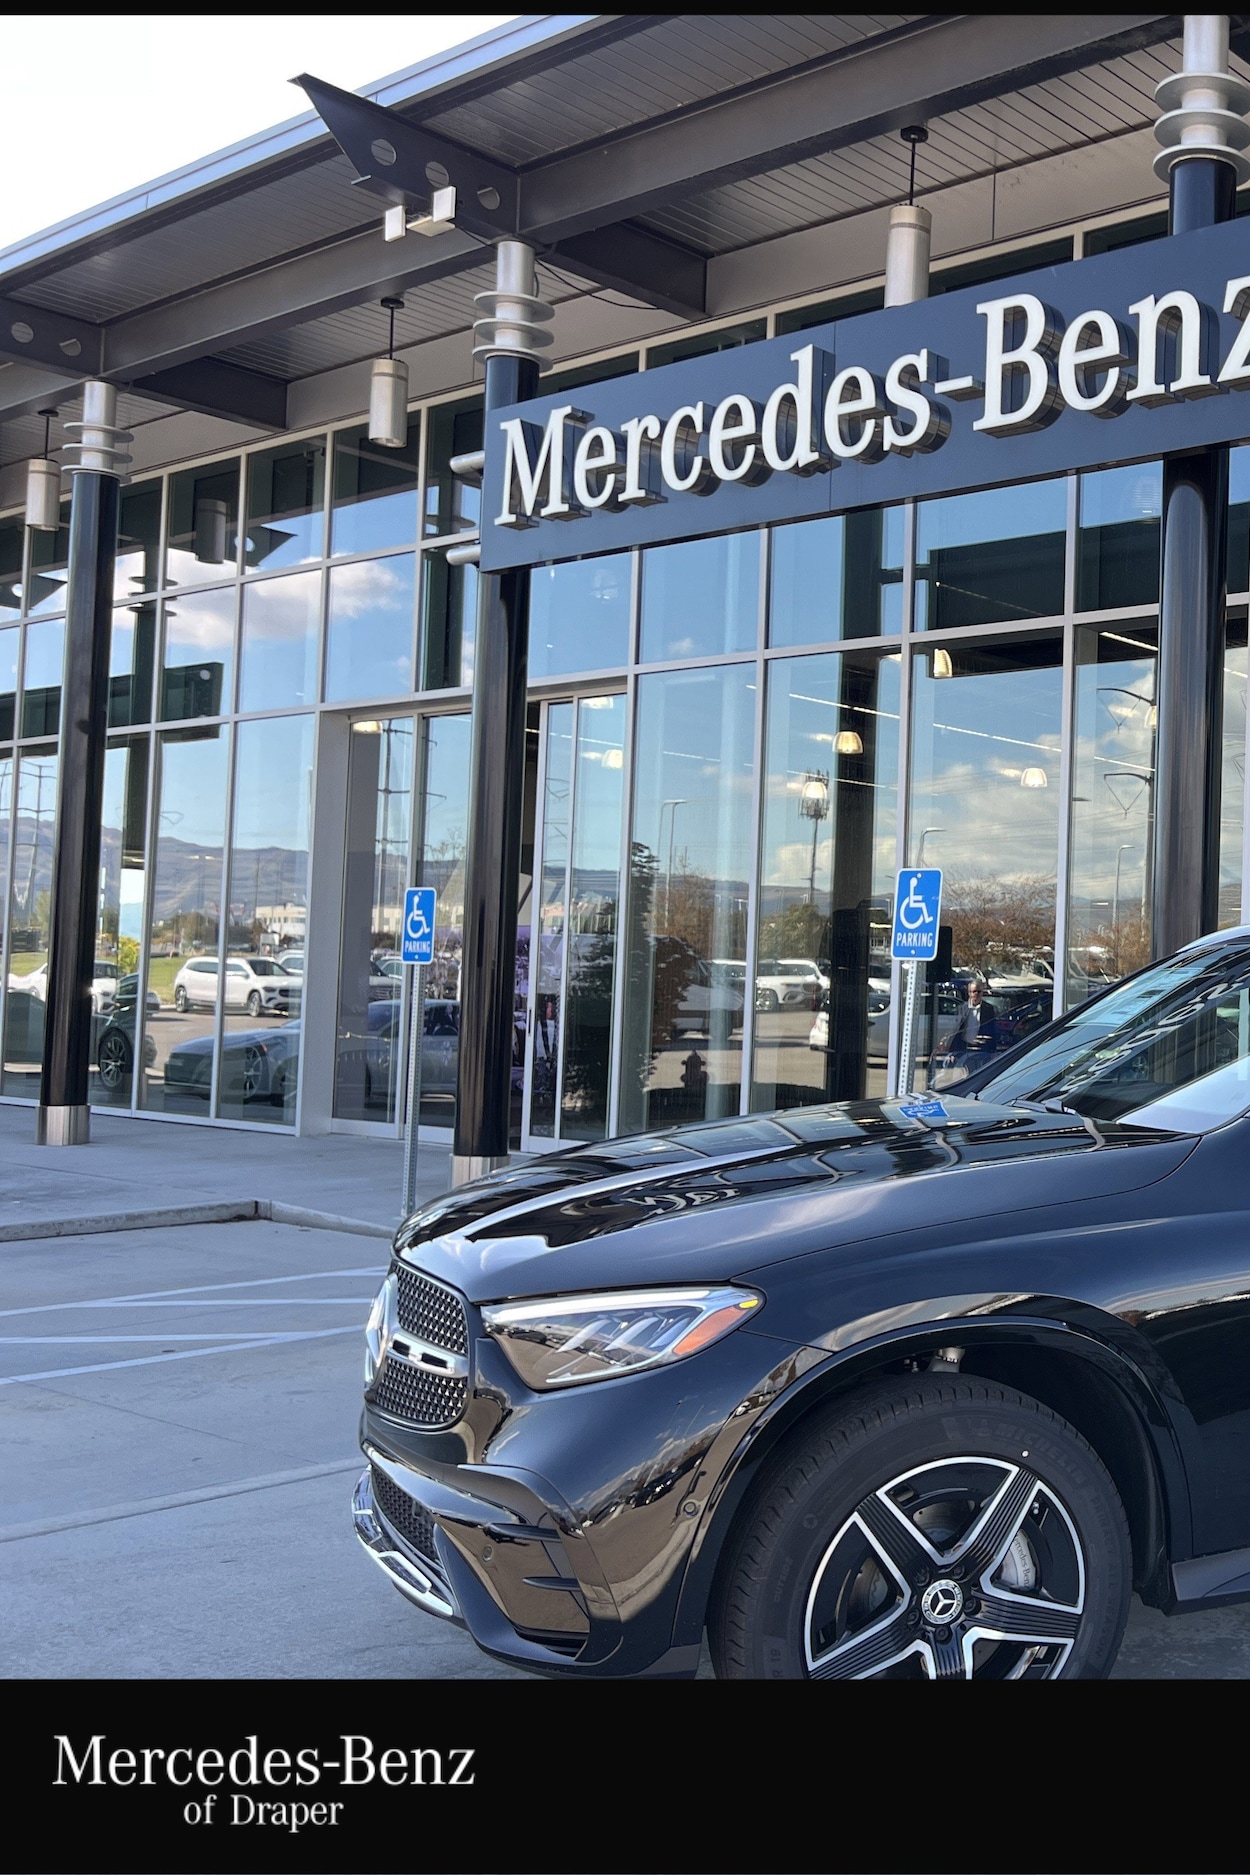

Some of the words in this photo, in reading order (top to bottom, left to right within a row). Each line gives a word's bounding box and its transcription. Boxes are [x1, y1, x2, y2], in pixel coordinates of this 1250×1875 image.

[404, 940, 430, 953] PARKING
[896, 932, 933, 947] PARKING
[770, 1648, 782, 1662] 19
